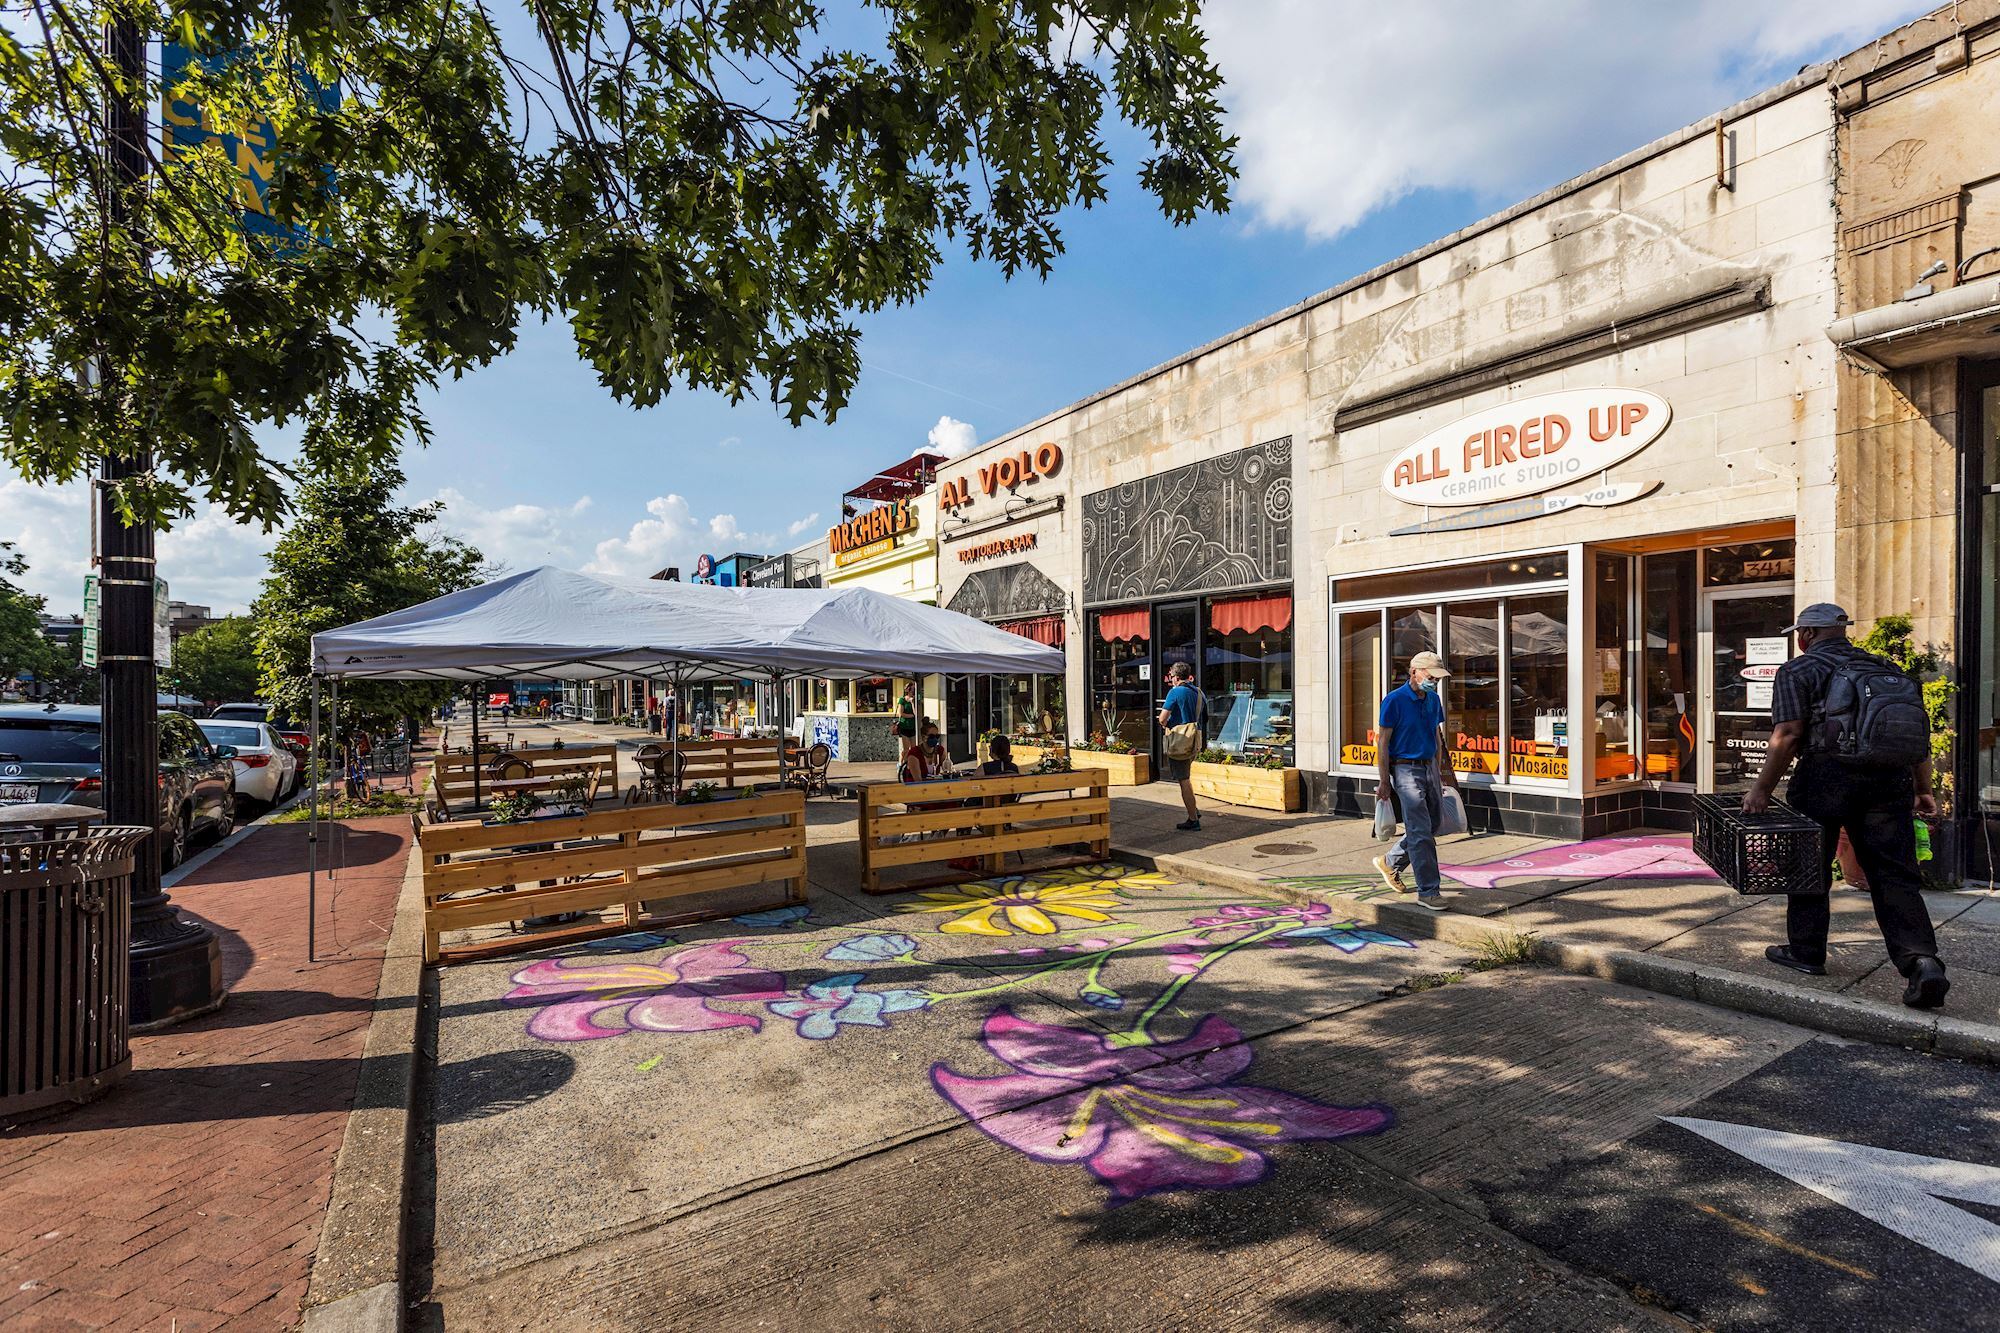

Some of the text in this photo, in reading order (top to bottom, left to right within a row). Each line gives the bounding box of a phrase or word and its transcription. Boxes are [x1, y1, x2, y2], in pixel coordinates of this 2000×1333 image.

[1394, 403, 1649, 488] ALL FIRED UP
[940, 442, 1061, 510] AL VOLO
[1441, 457, 1581, 498] CERAMIC STUDIO
[1482, 502, 1543, 521] PAINTED
[1548, 497, 1568, 508] BY
[1584, 488, 1617, 502] YOU
[841, 541, 888, 563] organic chinese
[957, 533, 1036, 561] TRATTORIA & BAR
[752, 561, 784, 581] Cleveland Park
[770, 577, 784, 588] Grill
[1456, 732, 1537, 755] Painting
[1727, 739, 1769, 749] STUDIO
[1352, 747, 1568, 776] Clay Glass Mosaics
